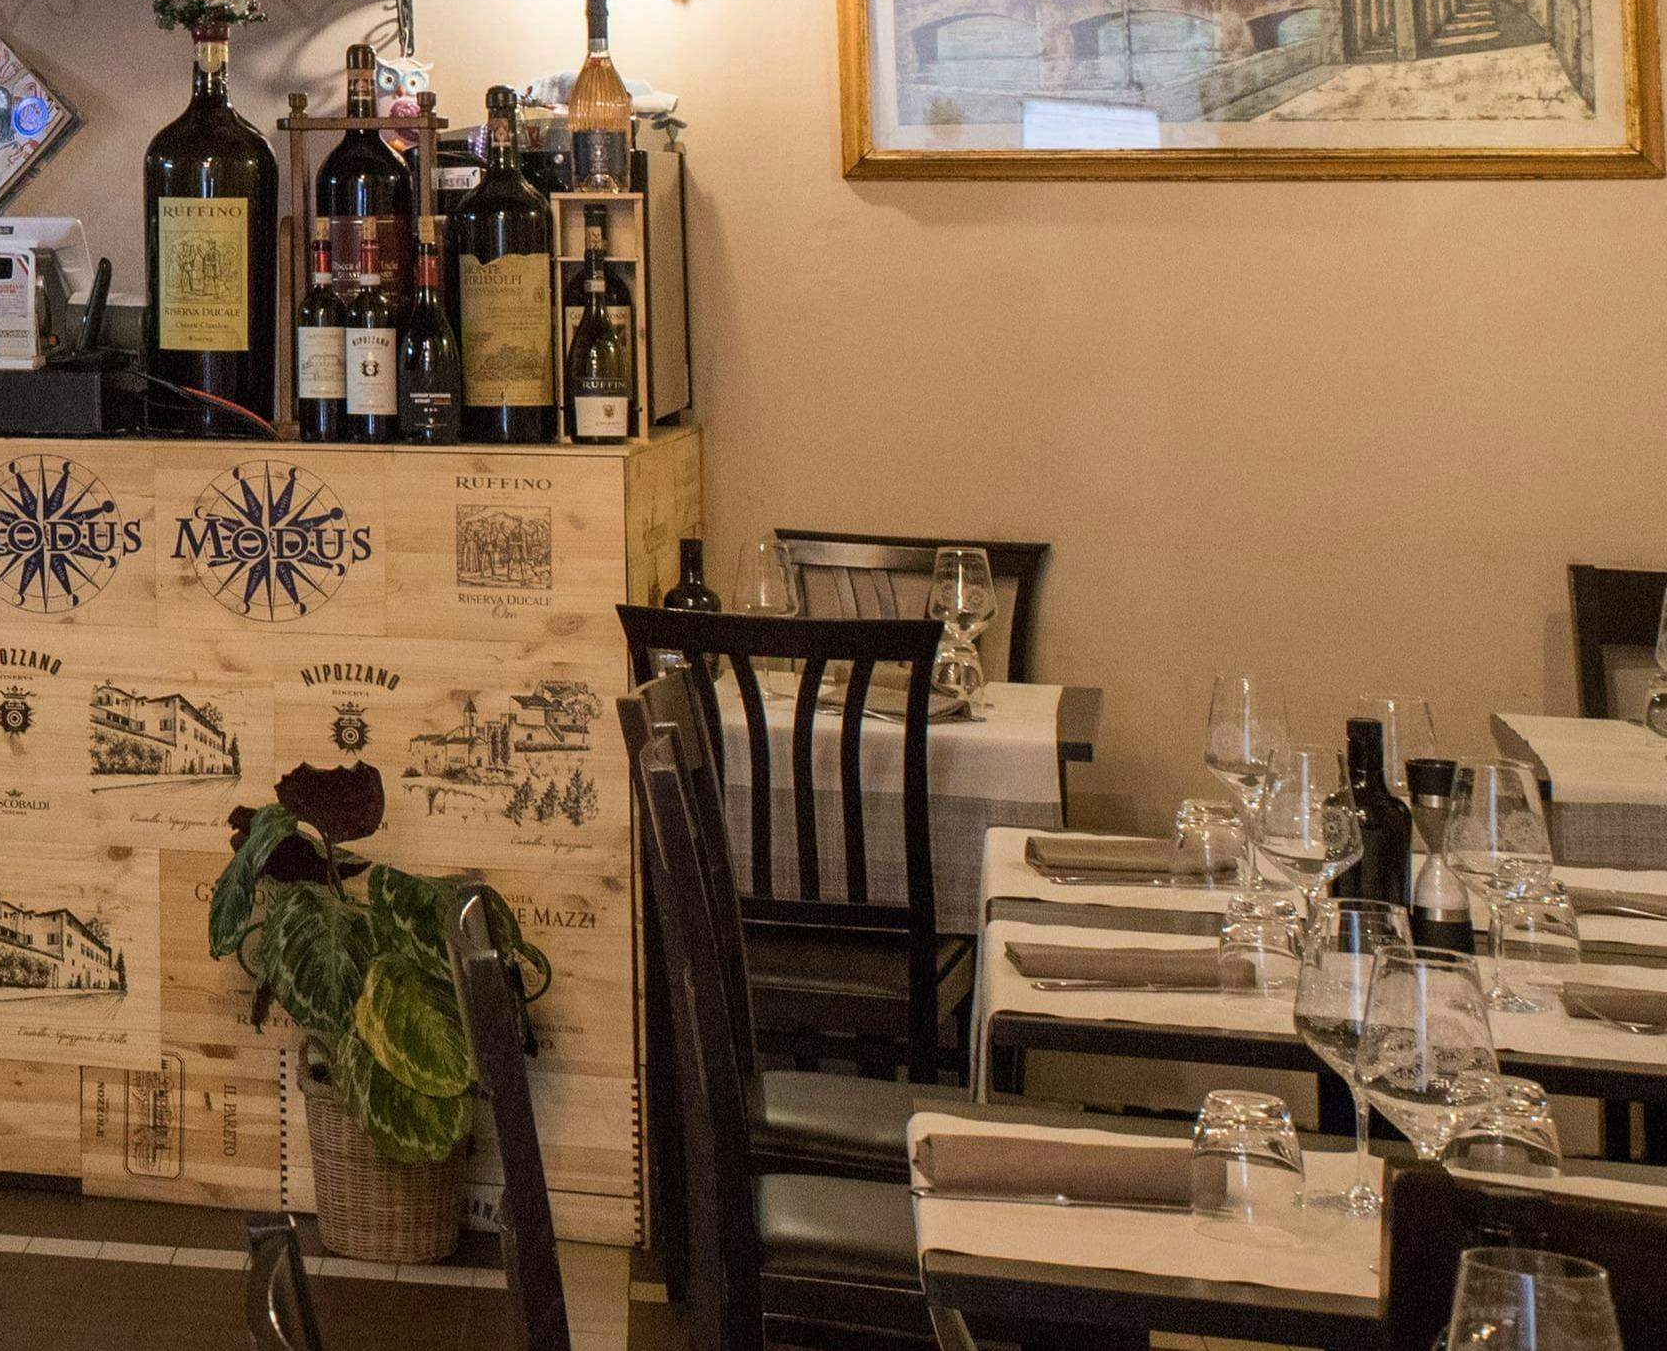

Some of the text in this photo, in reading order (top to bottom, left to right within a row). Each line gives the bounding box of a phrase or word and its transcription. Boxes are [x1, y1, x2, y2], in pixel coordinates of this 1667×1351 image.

[163, 205, 242, 218] RUFFINO
[203, 307, 241, 318] DUCALE
[582, 380, 627, 390] RUFFIN
[455, 476, 553, 491] RUFFINO
[170, 517, 373, 565] MODUS
[458, 592, 552, 607] RISERVA DUCALE
[300, 662, 401, 691] NIPOZZANO
[533, 907, 596, 929] MAZZI
[222, 1103, 238, 1158] PARETO
